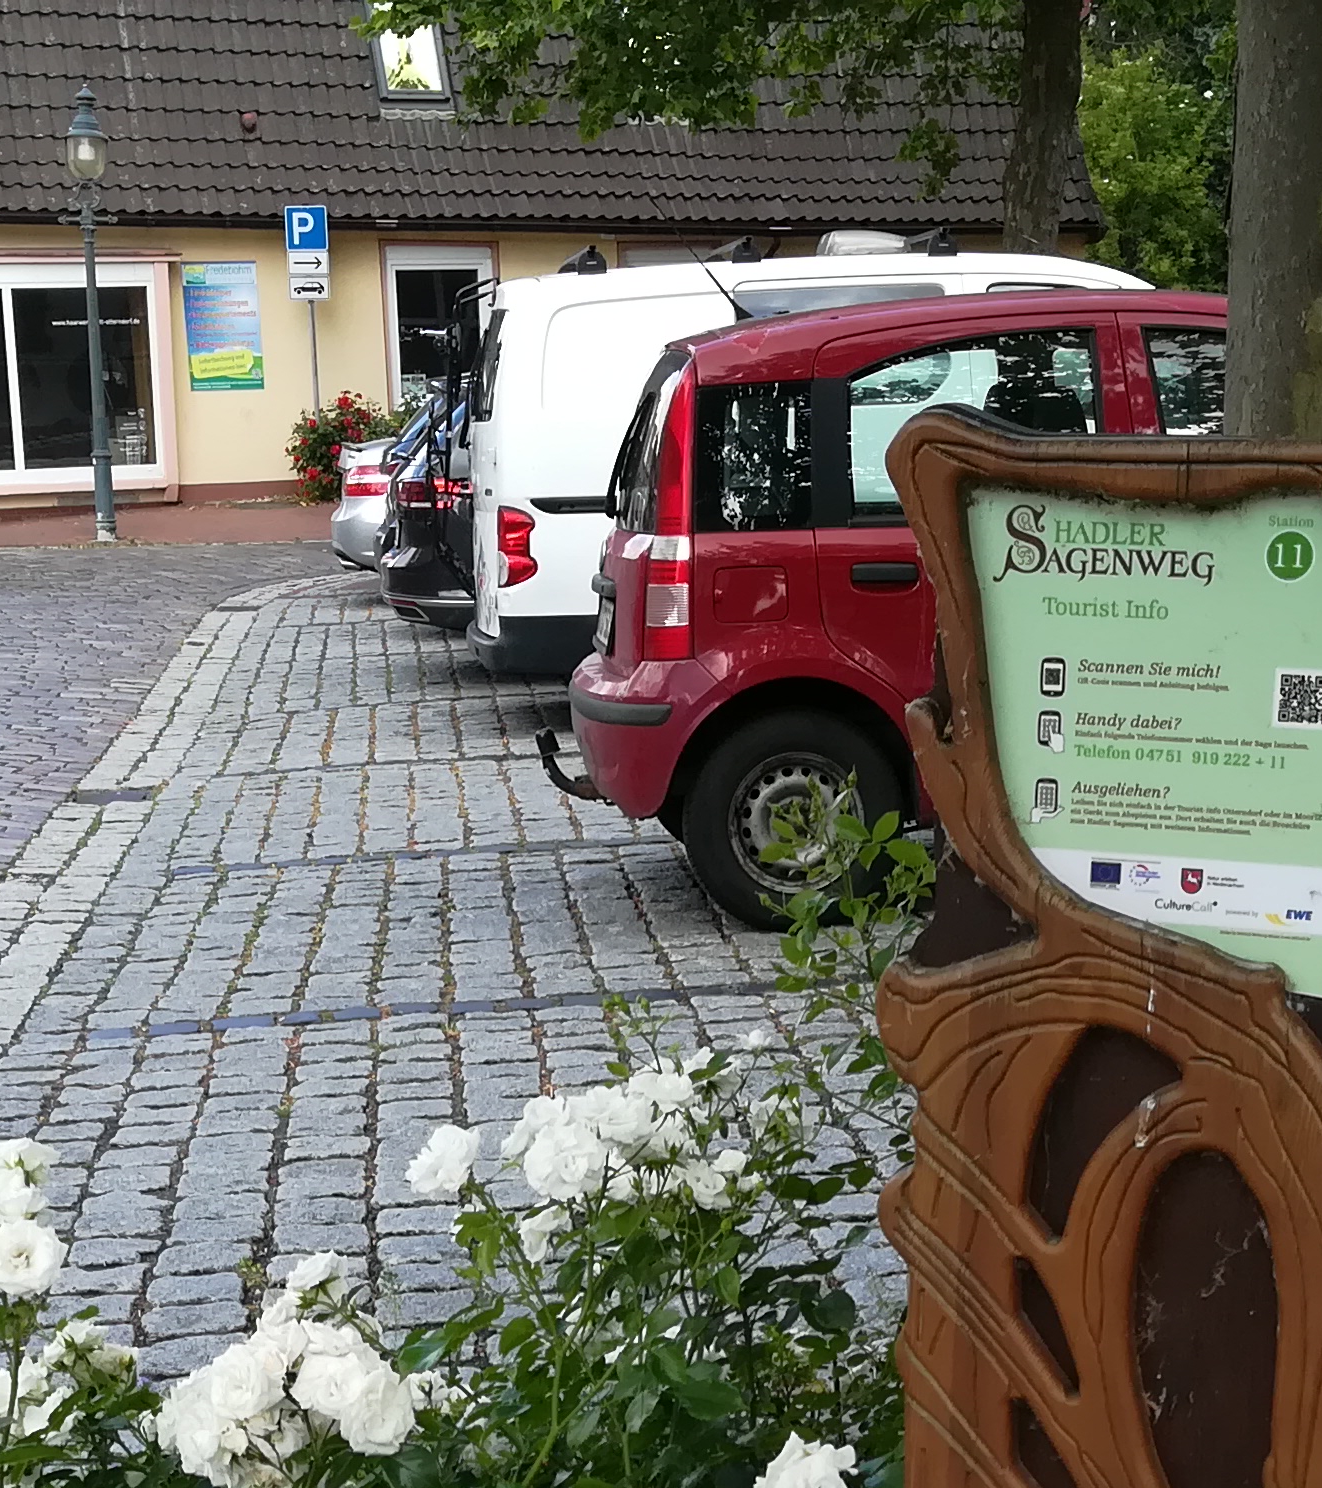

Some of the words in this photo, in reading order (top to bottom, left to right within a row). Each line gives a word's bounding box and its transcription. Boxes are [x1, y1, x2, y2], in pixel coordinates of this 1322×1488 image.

[291, 212, 315, 245] P
[1054, 518, 1166, 547] HADLER
[1268, 515, 1314, 528] Station
[992, 504, 1216, 587] SAGENWEG
[1273, 543, 1304, 569] 11
[1042, 597, 1119, 618] Tourist
[1125, 599, 1169, 620] Info
[1077, 658, 1144, 675] Scannen
[1148, 661, 1172, 676] Sie
[1176, 663, 1222, 679] mich!
[1075, 712, 1127, 731] Handy
[1130, 714, 1183, 731] dabei?
[1074, 744, 1131, 760] Telefon
[1135, 747, 1182, 763] 04751
[1192, 750, 1219, 765] 919
[1223, 753, 1251, 767] 222
[1255, 757, 1264, 765] +
[1270, 755, 1285, 769] 11
[1071, 781, 1170, 799] Ausgeliehen?
[1154, 897, 1214, 913] CultureCall
[1285, 909, 1313, 921] EWE
